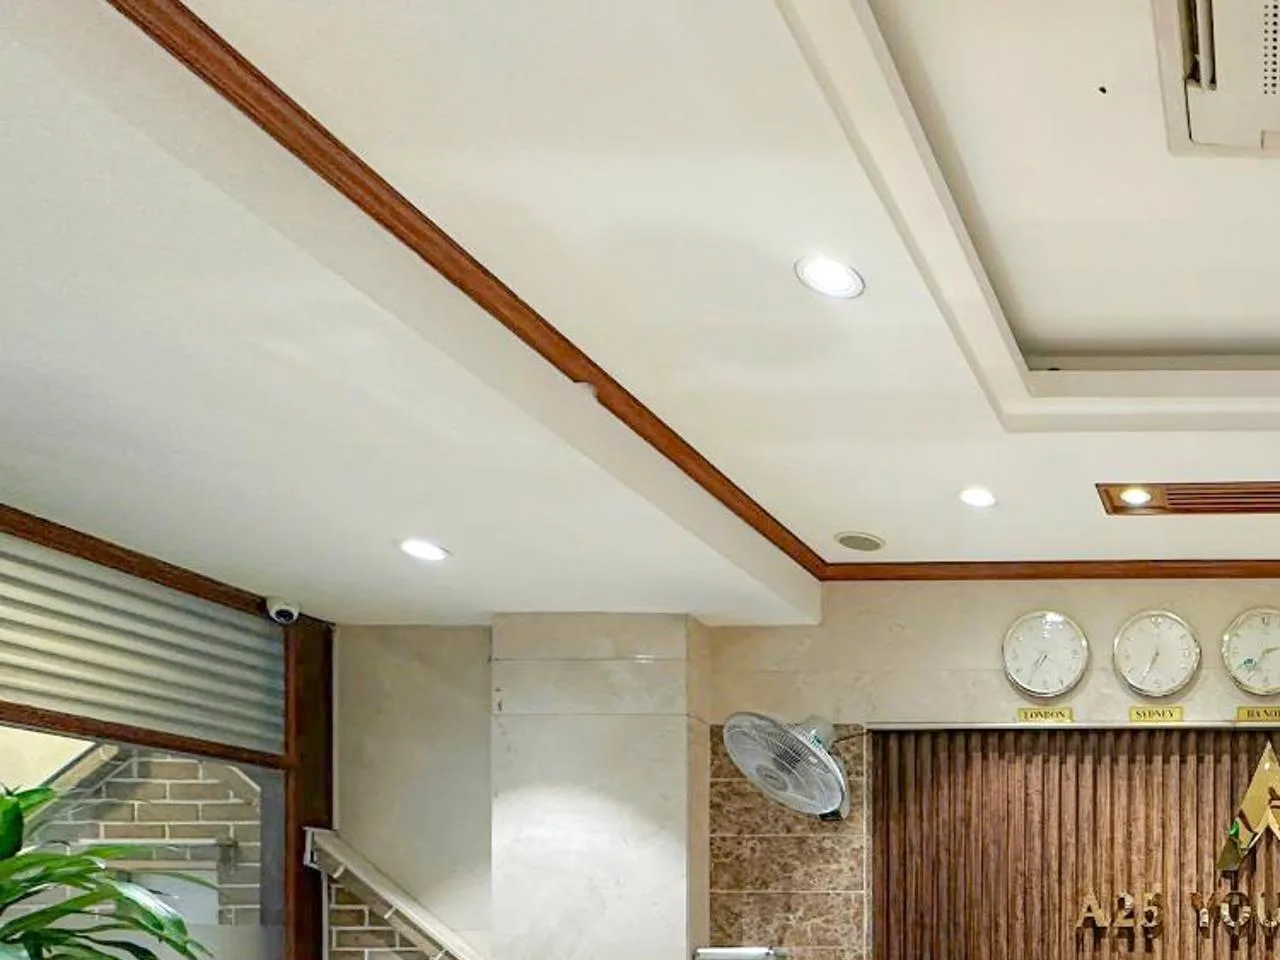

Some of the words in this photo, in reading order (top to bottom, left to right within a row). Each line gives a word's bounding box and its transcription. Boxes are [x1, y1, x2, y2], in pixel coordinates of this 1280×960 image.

[1023, 710, 1066, 720] LONDON
[1135, 710, 1175, 719] SYDNEY
[1075, 890, 1163, 929] A25
